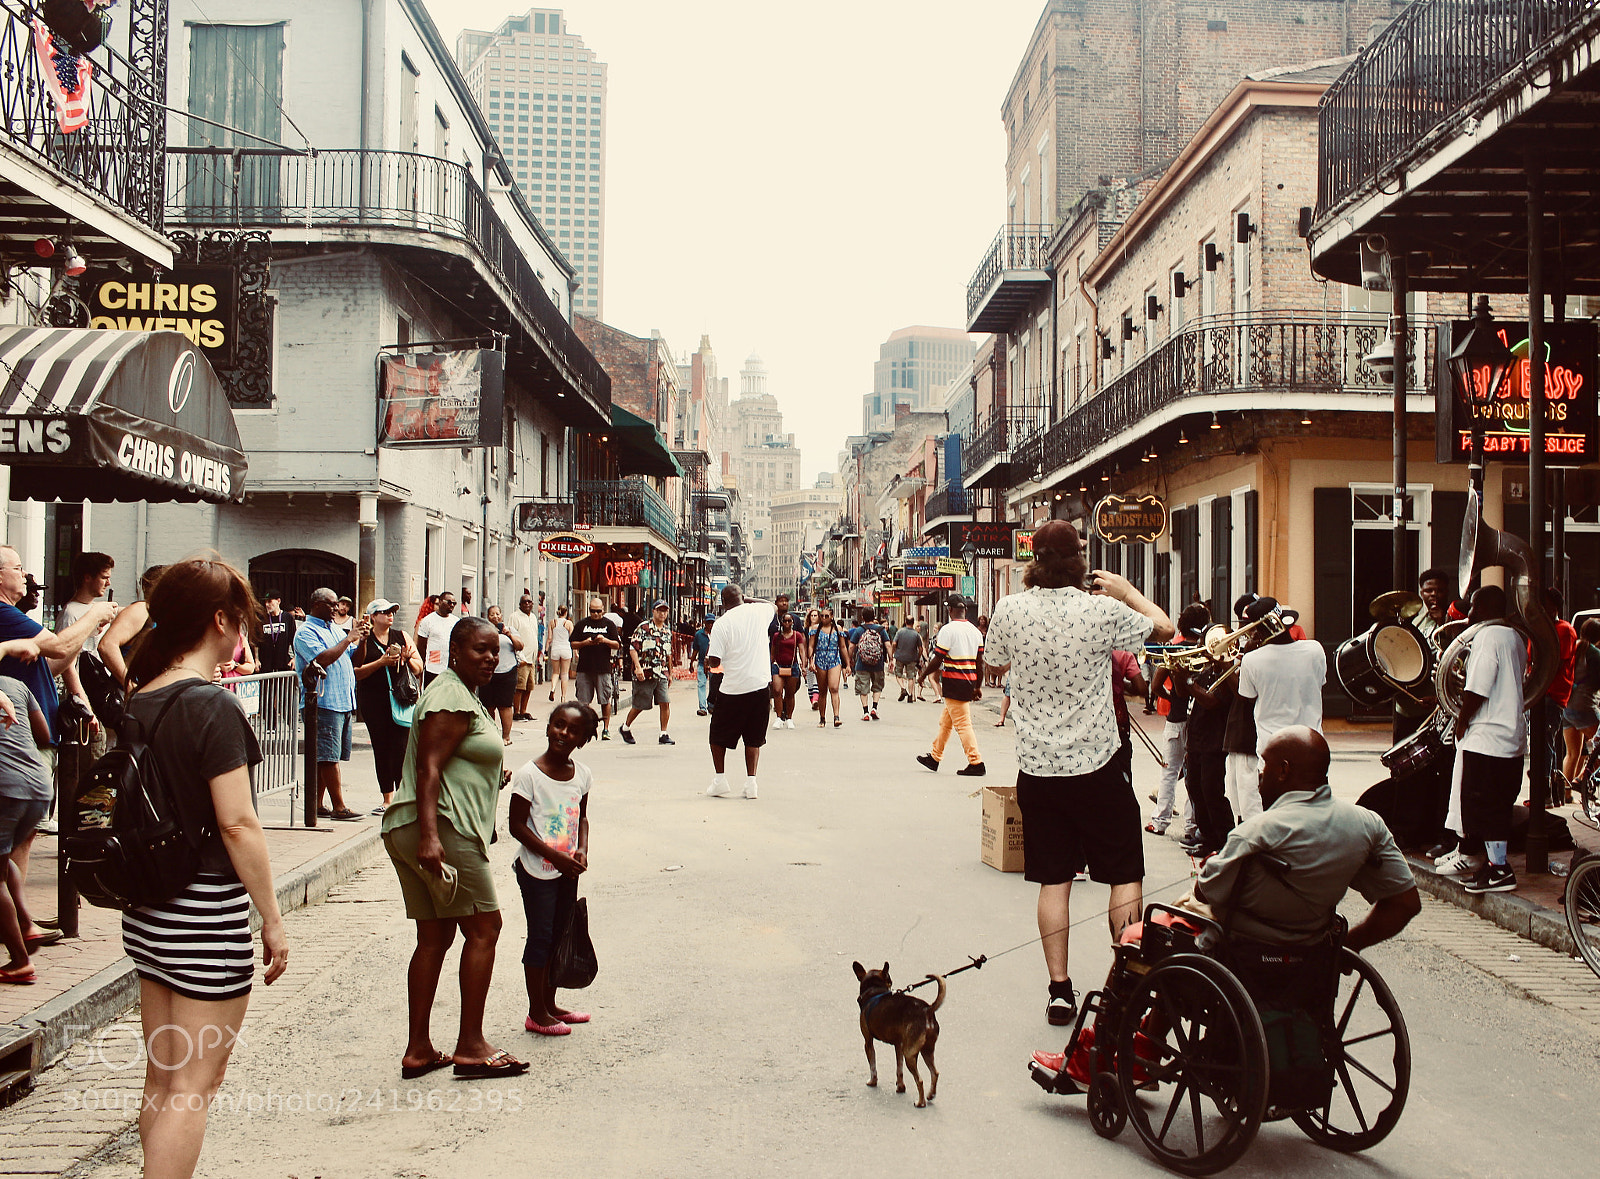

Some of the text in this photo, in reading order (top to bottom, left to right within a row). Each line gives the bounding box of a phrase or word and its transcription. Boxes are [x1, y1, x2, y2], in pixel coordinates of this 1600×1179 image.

[98, 281, 218, 313] CHRIS
[1471, 401, 1568, 421] DAIQUIS
[0, 420, 71, 454] ENS
[1461, 436, 1499, 451] PZA
[1500, 437, 1517, 451] BY
[1547, 437, 1585, 453] SLICE
[117, 433, 232, 494] CHRIS OWENS
[1101, 513, 1163, 527] BANDSTAND
[962, 524, 1011, 533] KAMA
[961, 534, 1010, 542] SUTRA
[540, 542, 594, 553] DIXIELAND
[974, 547, 1005, 556] ABARET
